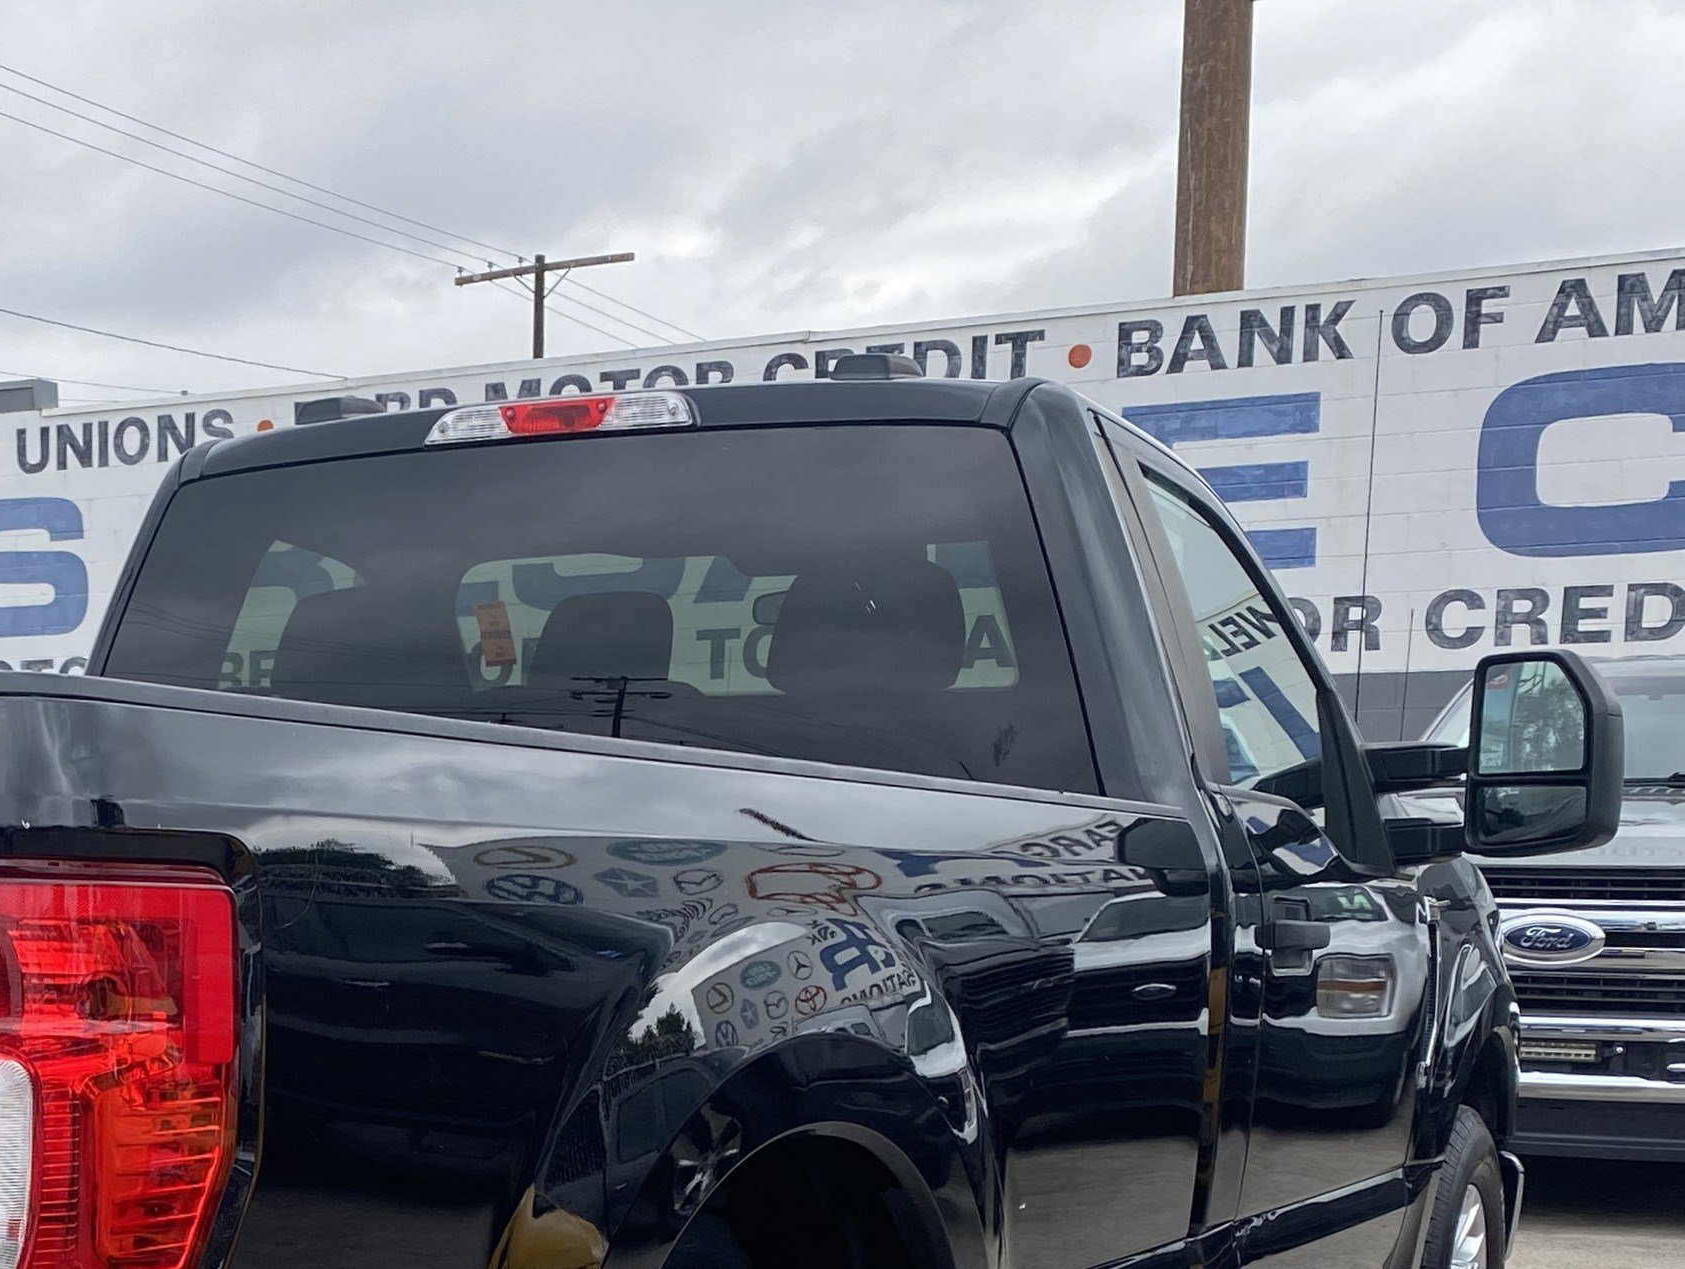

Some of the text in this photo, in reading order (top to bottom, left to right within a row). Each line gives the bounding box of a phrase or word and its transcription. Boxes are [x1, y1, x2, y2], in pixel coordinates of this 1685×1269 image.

[15, 410, 235, 475] UNIONS
[762, 329, 1046, 382] CDIT
[1117, 300, 1356, 378] BANK
[1391, 286, 1511, 354] OF
[1519, 926, 1575, 950] Ford
